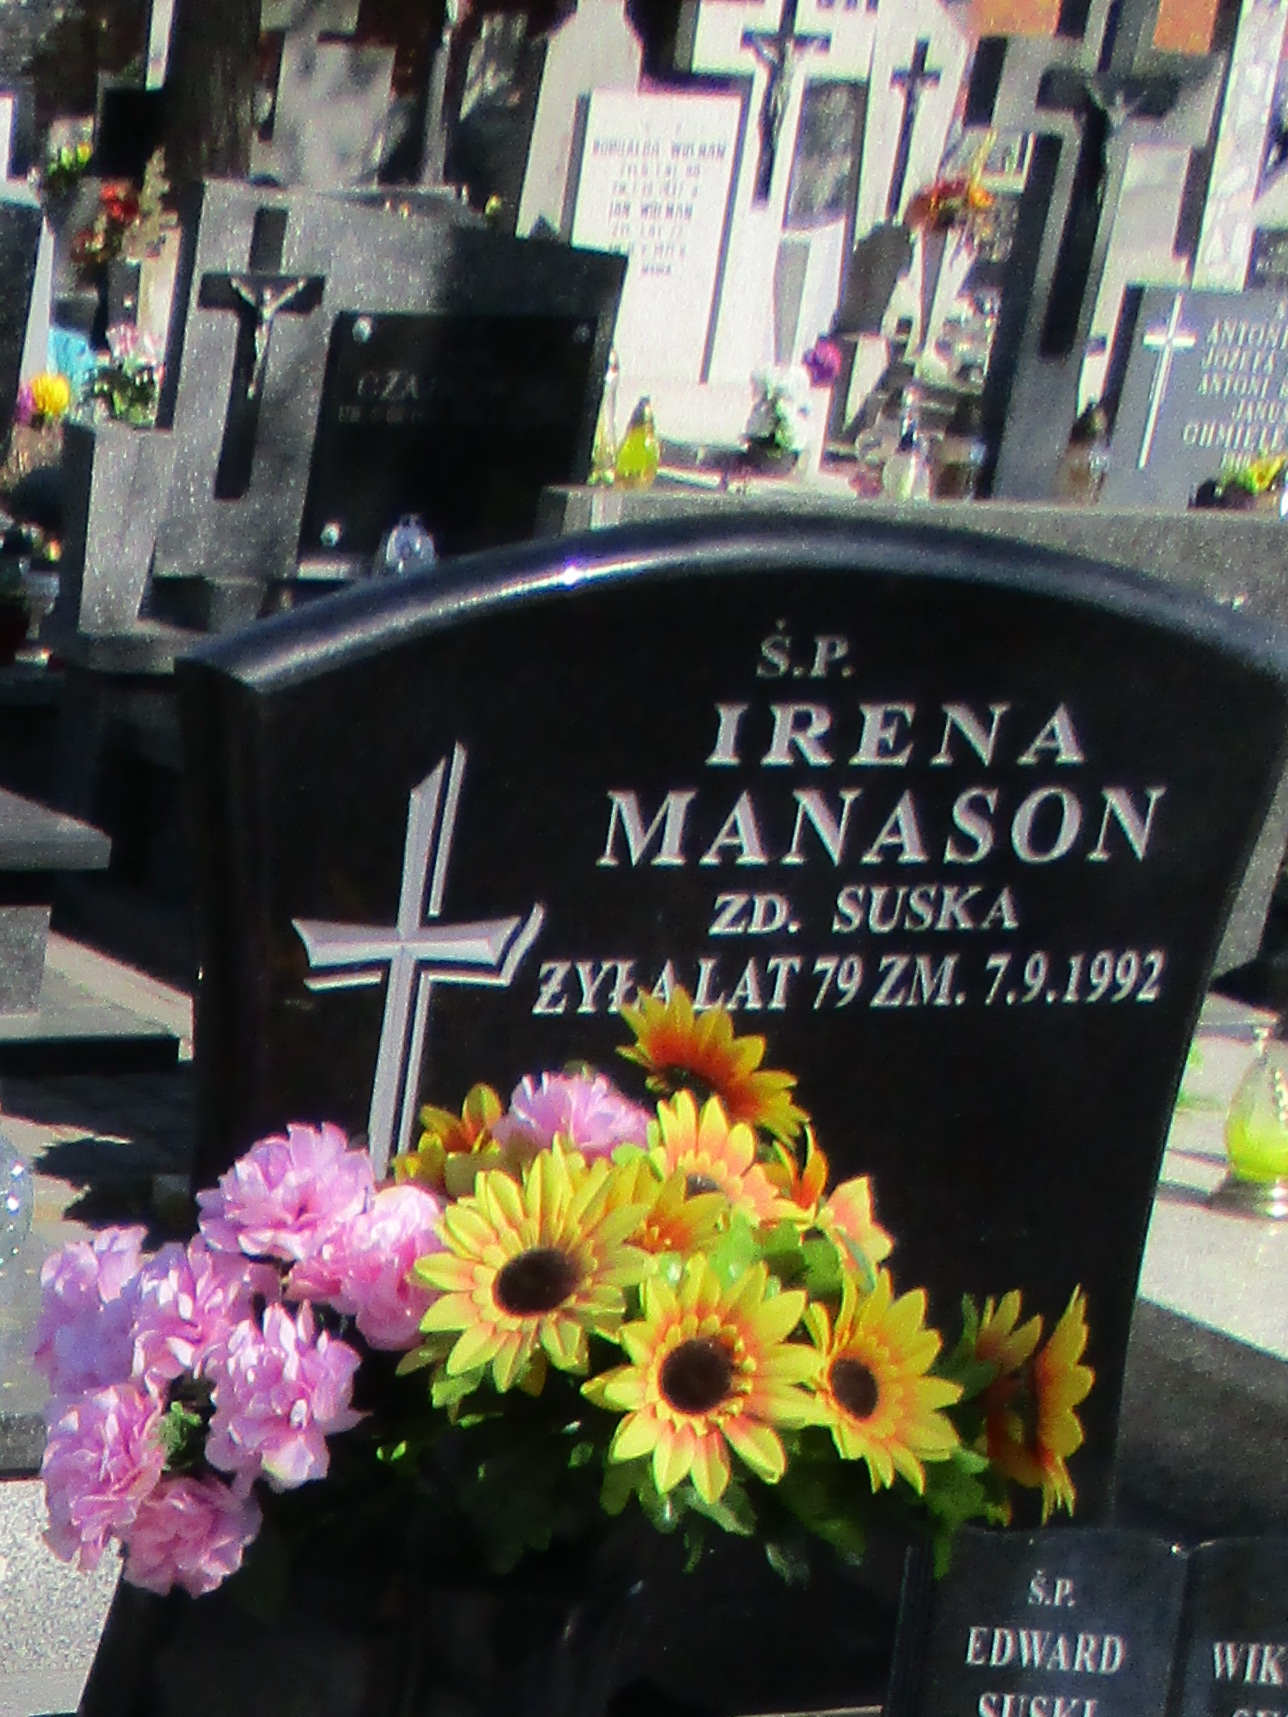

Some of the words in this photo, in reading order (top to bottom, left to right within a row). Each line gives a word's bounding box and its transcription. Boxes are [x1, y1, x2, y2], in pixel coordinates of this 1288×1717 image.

[704, 701, 1087, 767] IRENA
[595, 785, 1169, 868] MANASON
[708, 892, 802, 937] ZD.
[832, 884, 1021, 933] SUSKA
[692, 955, 803, 1012] LAT
[812, 953, 864, 1011] 79
[869, 953, 967, 1010] ZM.
[964, 1625, 1126, 1676] EDWARD
